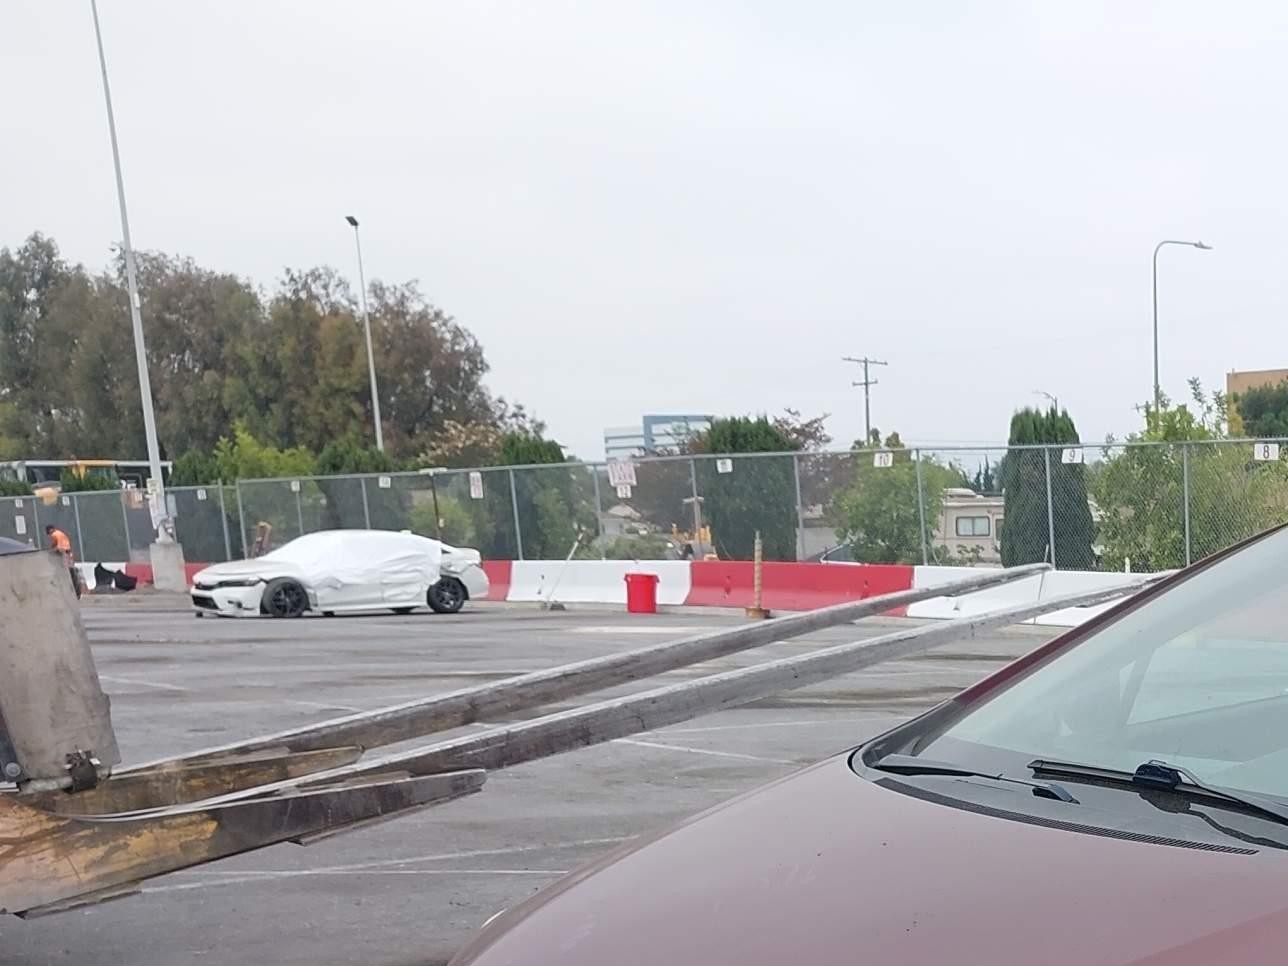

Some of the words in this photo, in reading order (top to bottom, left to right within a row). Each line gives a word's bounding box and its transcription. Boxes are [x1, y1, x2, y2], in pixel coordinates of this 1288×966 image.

[1069, 450, 1076, 462] 9
[1263, 444, 1270, 459] 8
[879, 453, 890, 466] 10
